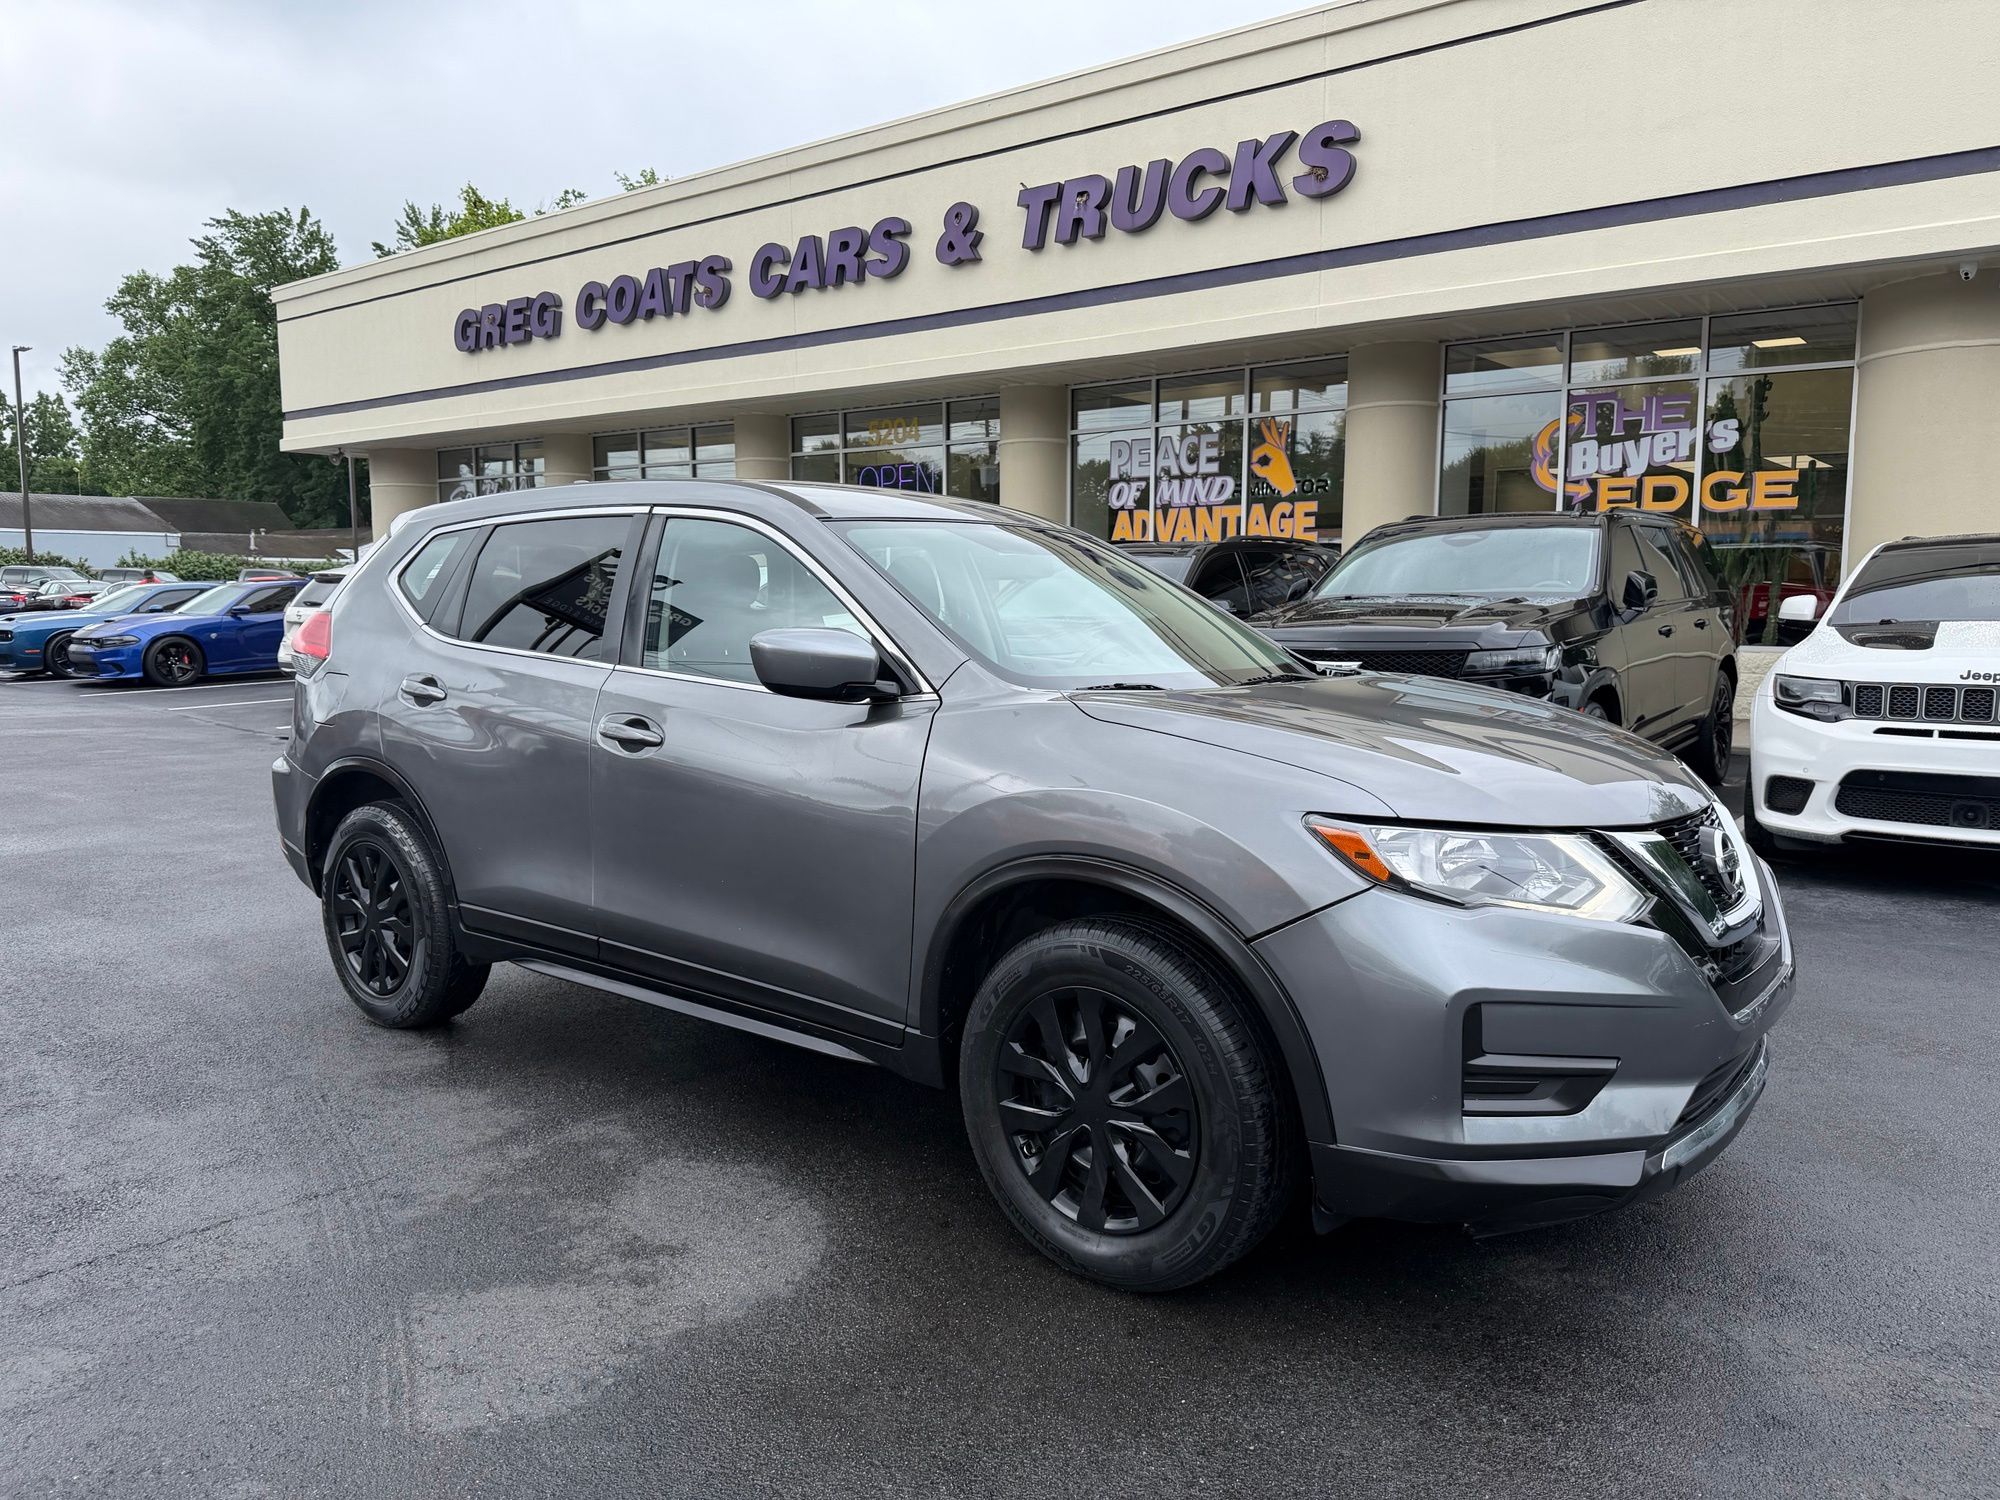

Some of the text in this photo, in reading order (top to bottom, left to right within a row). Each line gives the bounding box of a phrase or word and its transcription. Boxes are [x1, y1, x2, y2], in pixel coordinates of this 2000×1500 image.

[454, 119, 1361, 353] GREG COATS CARS & TRUCKS
[867, 416, 920, 446] 5204
[1569, 391, 1692, 438] THE
[1109, 433, 1220, 480] PEACE
[1109, 475, 1236, 510] OF MIND
[1595, 470, 1800, 513] EDGE
[1111, 501, 1319, 543] ADVANTAGE
[1123, 965, 1191, 1025] 225/65R17
